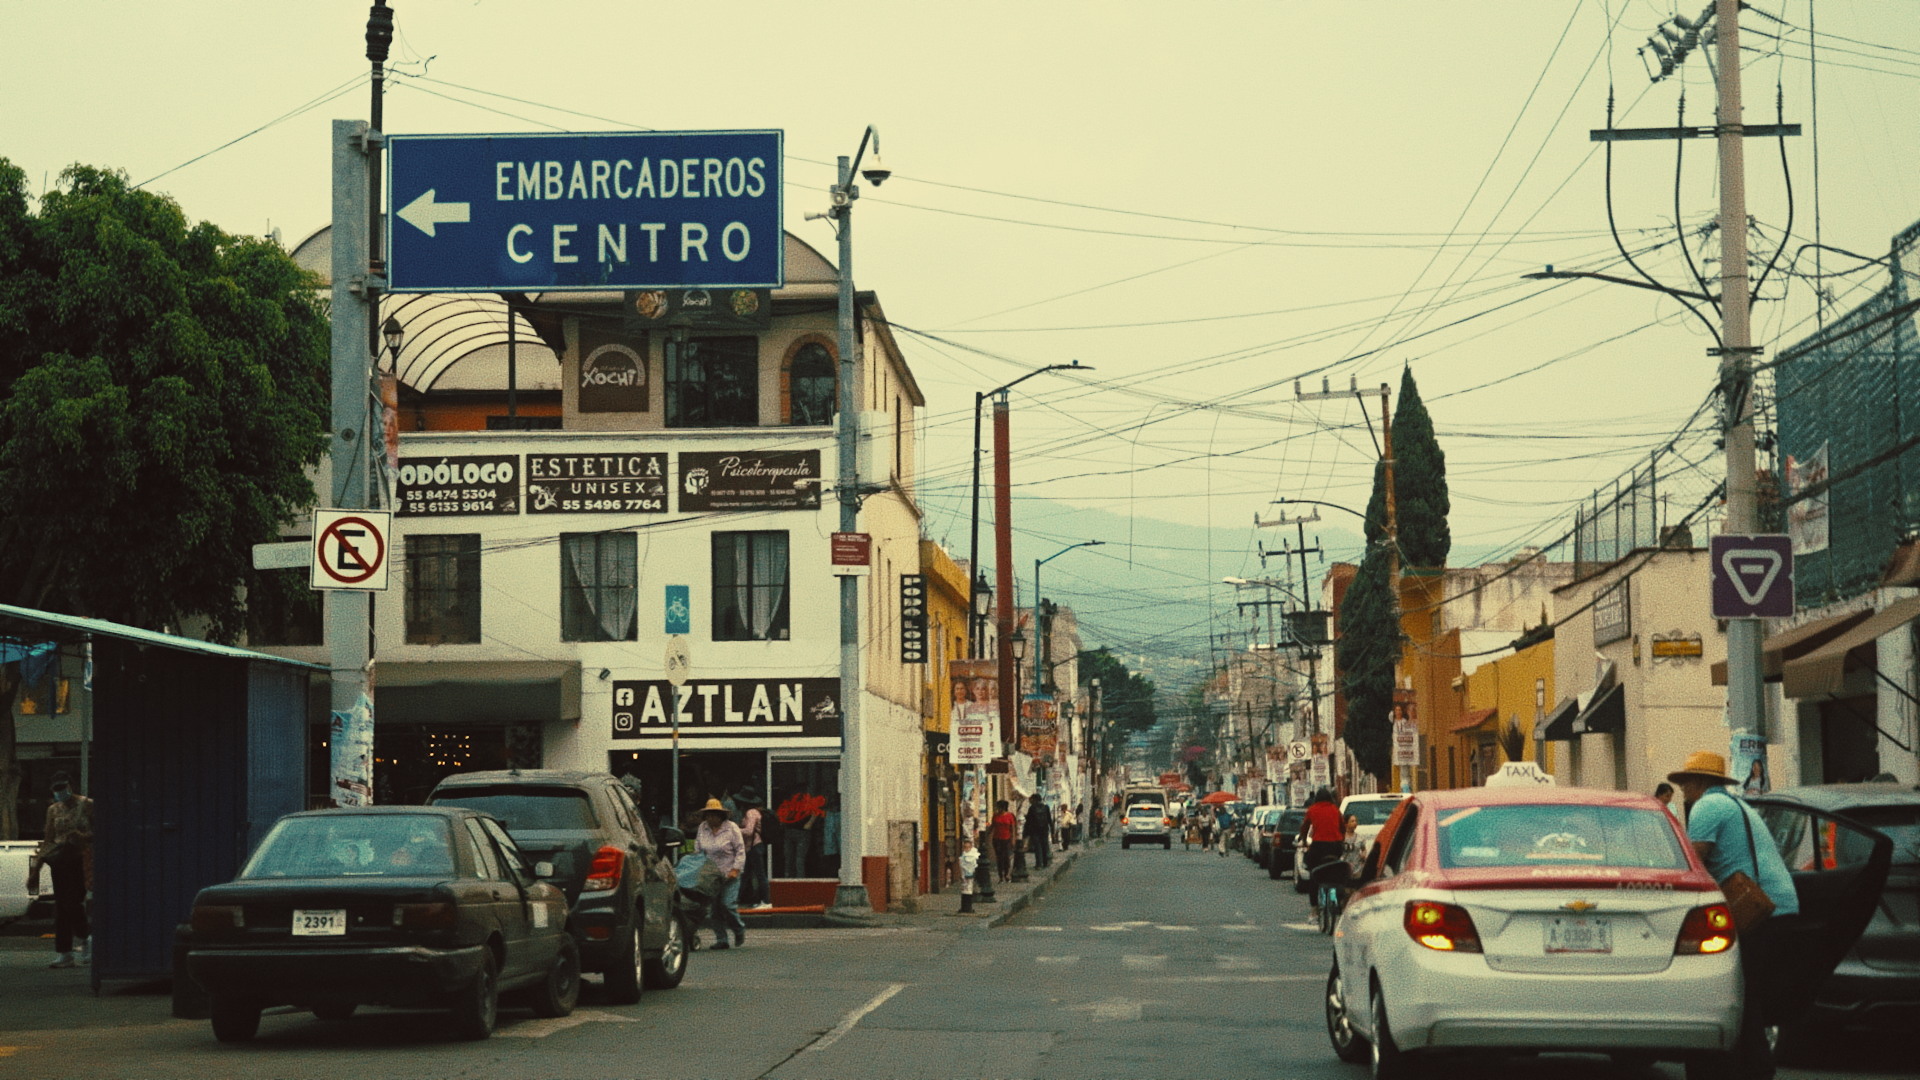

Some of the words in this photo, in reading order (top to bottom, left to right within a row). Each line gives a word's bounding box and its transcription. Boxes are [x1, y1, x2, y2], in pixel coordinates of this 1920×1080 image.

[496, 157, 766, 201] EMBARCADEROS
[506, 222, 752, 264] CENTRO
[581, 366, 637, 388] XOCHI
[399, 457, 514, 486] ODÓLOGO
[531, 456, 662, 477] ESTETICA
[718, 455, 812, 485] Psicoterapeuta
[406, 490, 423, 500] 55
[426, 489, 459, 500] 8474
[462, 488, 497, 500] 5304
[571, 482, 646, 494] UNISEX
[409, 502, 426, 512] 55
[428, 501, 459, 512] 6133
[462, 500, 494, 512] 9614
[562, 500, 581, 510] 55
[584, 499, 621, 510] 5496
[625, 499, 662, 510] 7764
[640, 683, 803, 724] AZTLAN
[958, 747, 983, 755] CIRCE
[1504, 766, 1534, 777] TAXI
[304, 916, 334, 928] 2391
